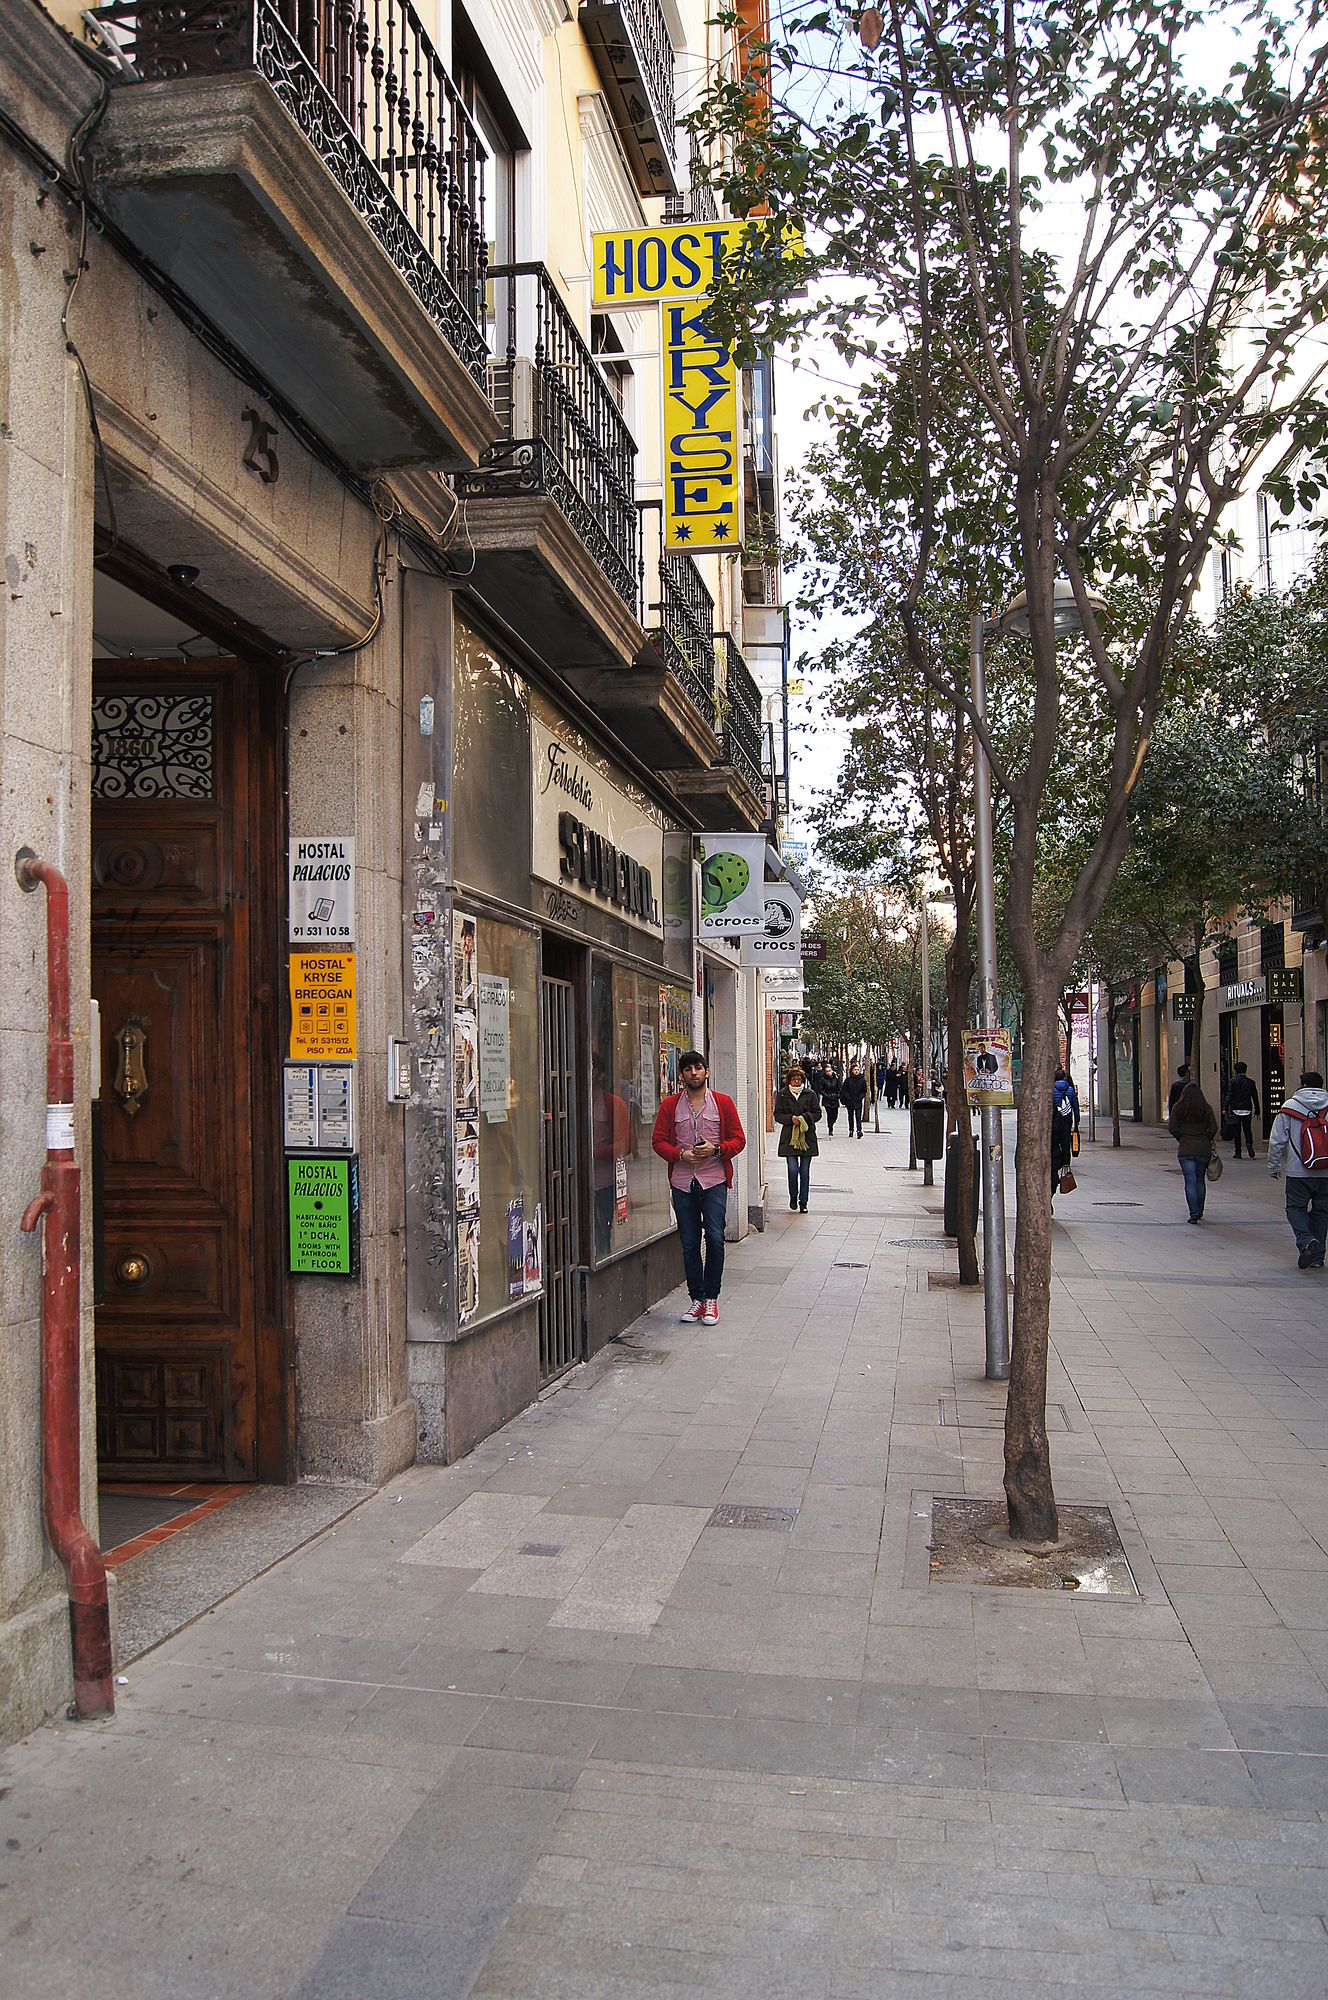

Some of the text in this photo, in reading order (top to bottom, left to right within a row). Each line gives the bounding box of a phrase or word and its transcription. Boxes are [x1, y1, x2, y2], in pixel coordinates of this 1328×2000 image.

[600, 224, 795, 295] HOST
[668, 305, 733, 517] KRYSE
[105, 739, 154, 757] 1860
[299, 843, 345, 859] HOSTAL
[292, 865, 351, 881] PALACIOS
[293, 927, 349, 936] 91 531 10 58
[301, 960, 345, 969] HOSTAL
[304, 973, 342, 982] KRYSE
[295, 989, 352, 999] BREOGAN
[299, 1166, 337, 1179] HOSTAL
[294, 1182, 343, 1197] PALACIOS
[319, 1221, 337, 1229] BAÑO
[311, 1232, 339, 1241] DCHA.
[312, 1260, 341, 1269] FLOOR
